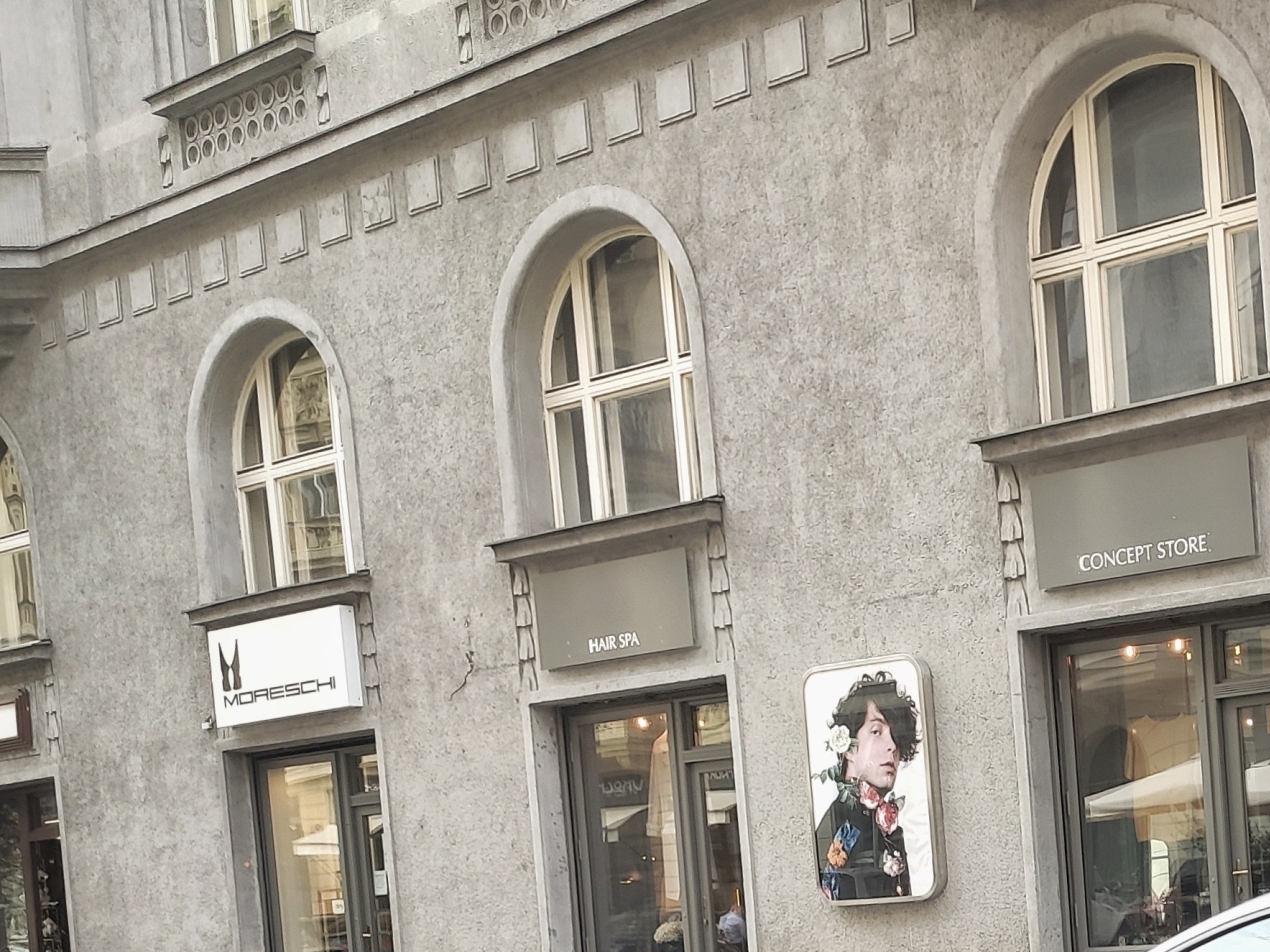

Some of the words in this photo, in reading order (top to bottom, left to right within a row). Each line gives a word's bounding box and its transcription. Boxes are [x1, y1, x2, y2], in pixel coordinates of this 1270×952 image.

[1079, 543, 1153, 571] CONCEPT
[1157, 534, 1208, 559] STORE
[588, 635, 617, 654] HAIR
[618, 631, 640, 649] SPA
[223, 675, 336, 708] MORESCHI
